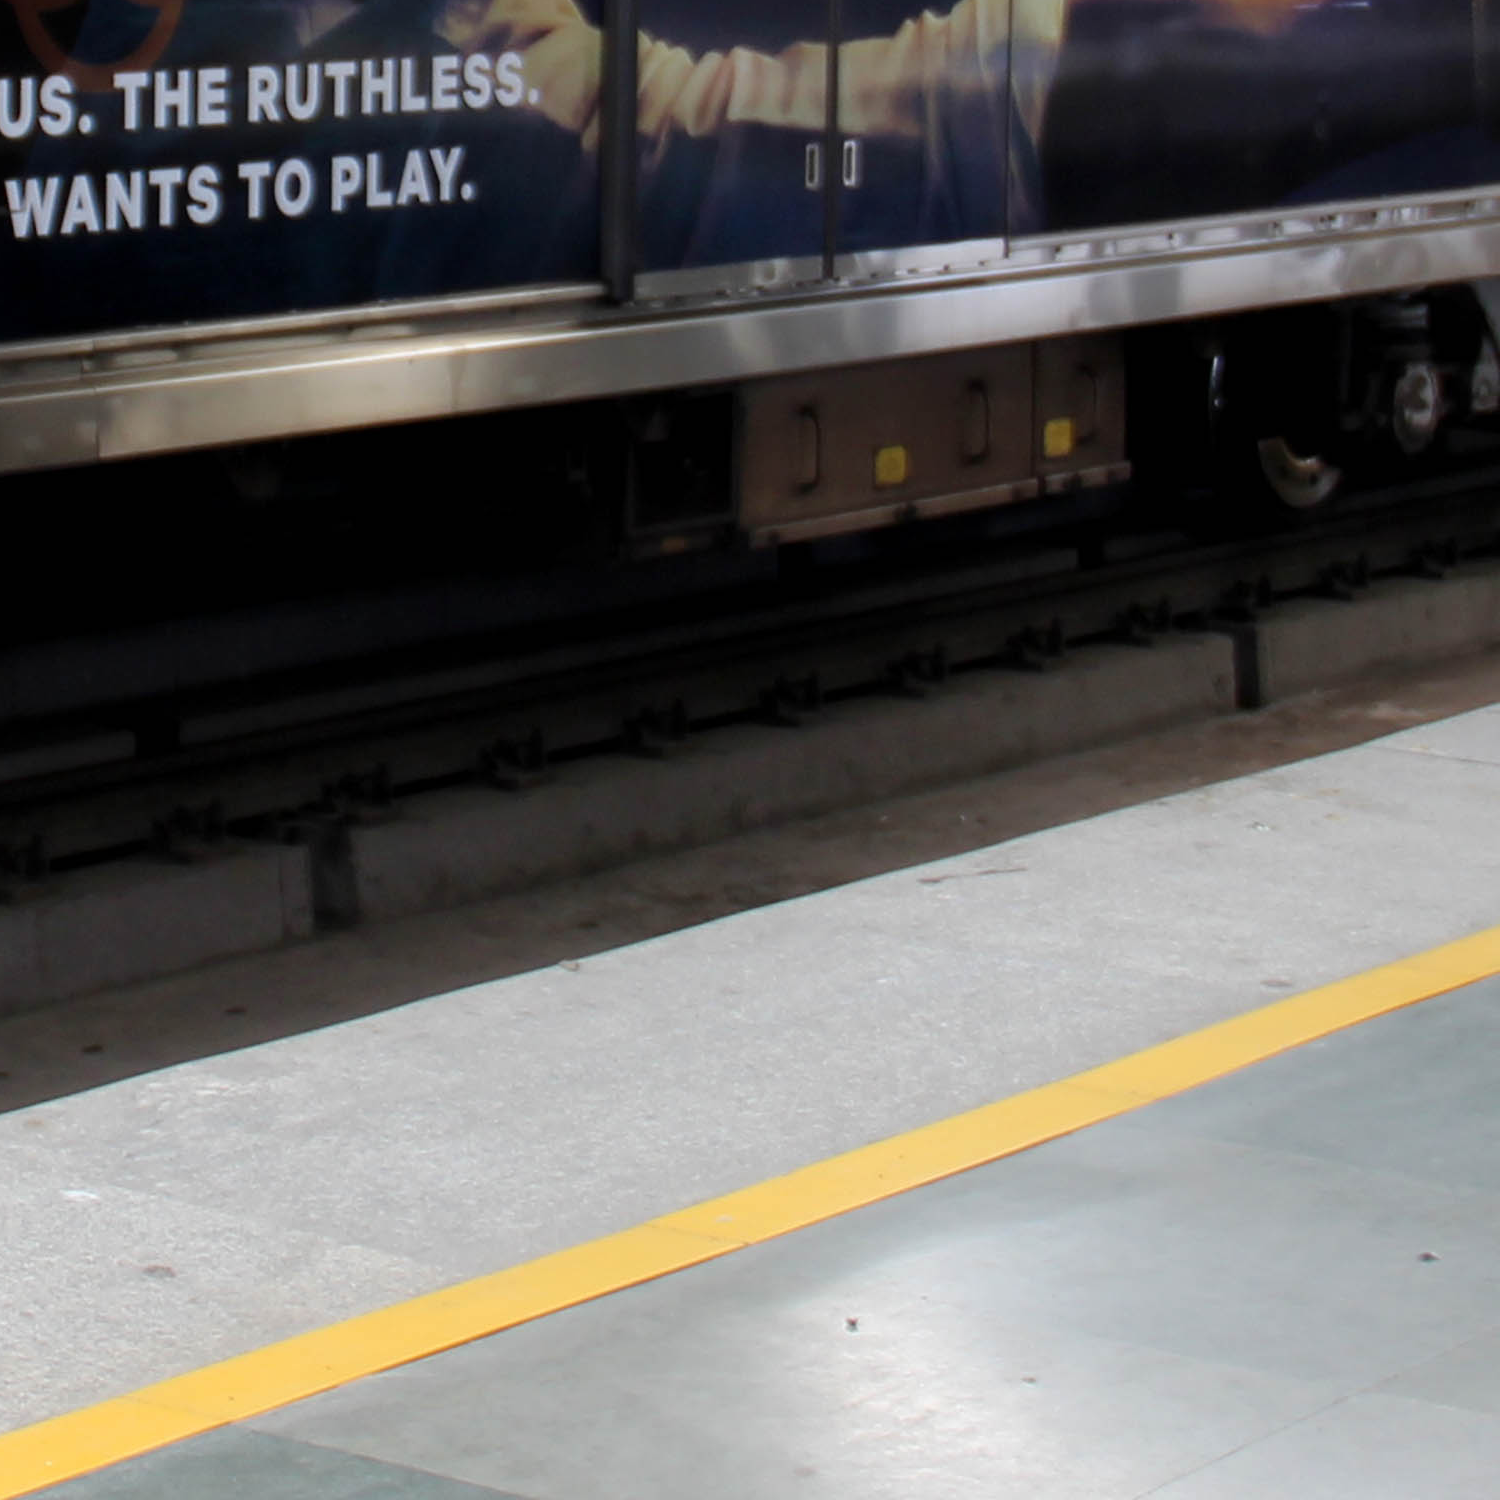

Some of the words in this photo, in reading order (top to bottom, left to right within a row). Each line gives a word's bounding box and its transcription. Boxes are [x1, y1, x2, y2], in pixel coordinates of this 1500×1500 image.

[113, 66, 229, 132] THE
[251, 52, 543, 124] RUTHLESS.
[5, 165, 221, 238] WANTS
[238, 158, 314, 220] TO
[331, 146, 475, 212] PLAY.
